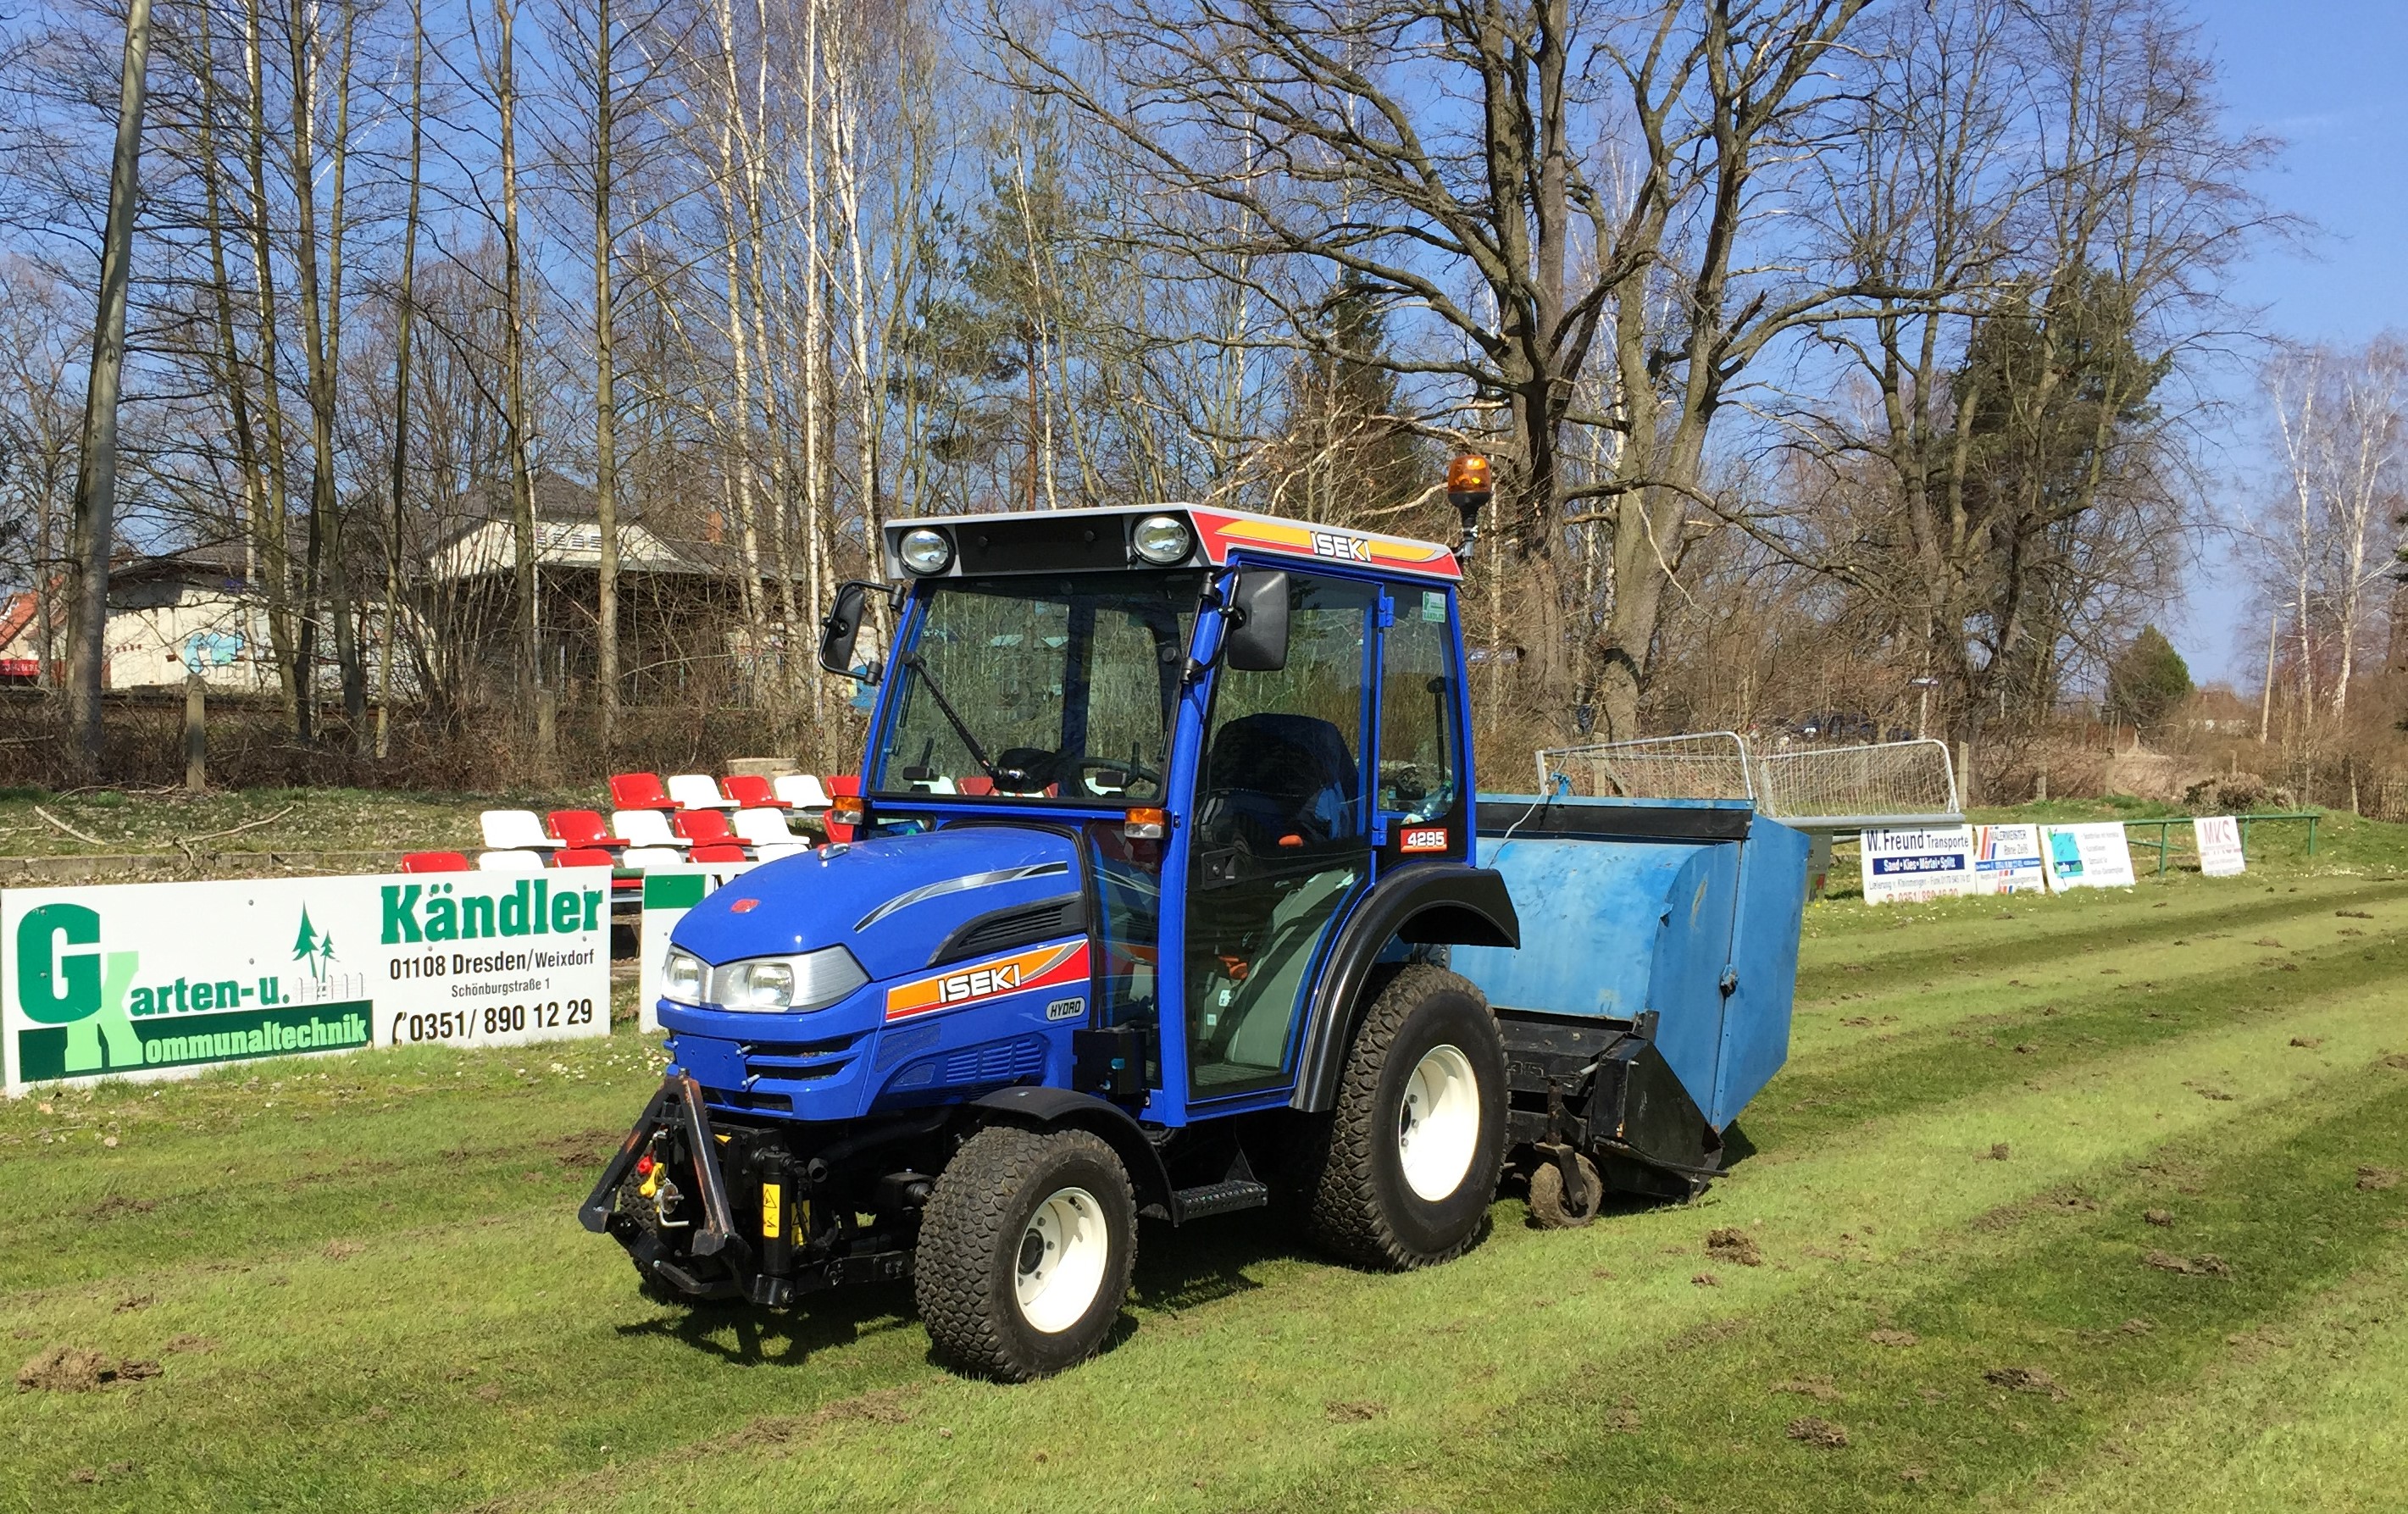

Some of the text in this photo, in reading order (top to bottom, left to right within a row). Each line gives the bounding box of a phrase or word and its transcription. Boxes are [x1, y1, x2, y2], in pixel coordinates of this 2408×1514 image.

[1310, 531, 1372, 563] ISEKI
[1407, 831, 1445, 847] 4295
[1867, 829, 1969, 851] W. Freund Transporte
[381, 878, 603, 945] Kändler
[390, 948, 595, 980] 01108 Dresden/Weixdorf
[452, 977, 551, 998] Schönburgstraße 1
[938, 962, 1023, 1004] ISEKI
[484, 1005, 525, 1034] 890
[533, 1001, 560, 1029] 12
[567, 998, 593, 1026] 29
[1050, 1000, 1083, 1018] HYDRO
